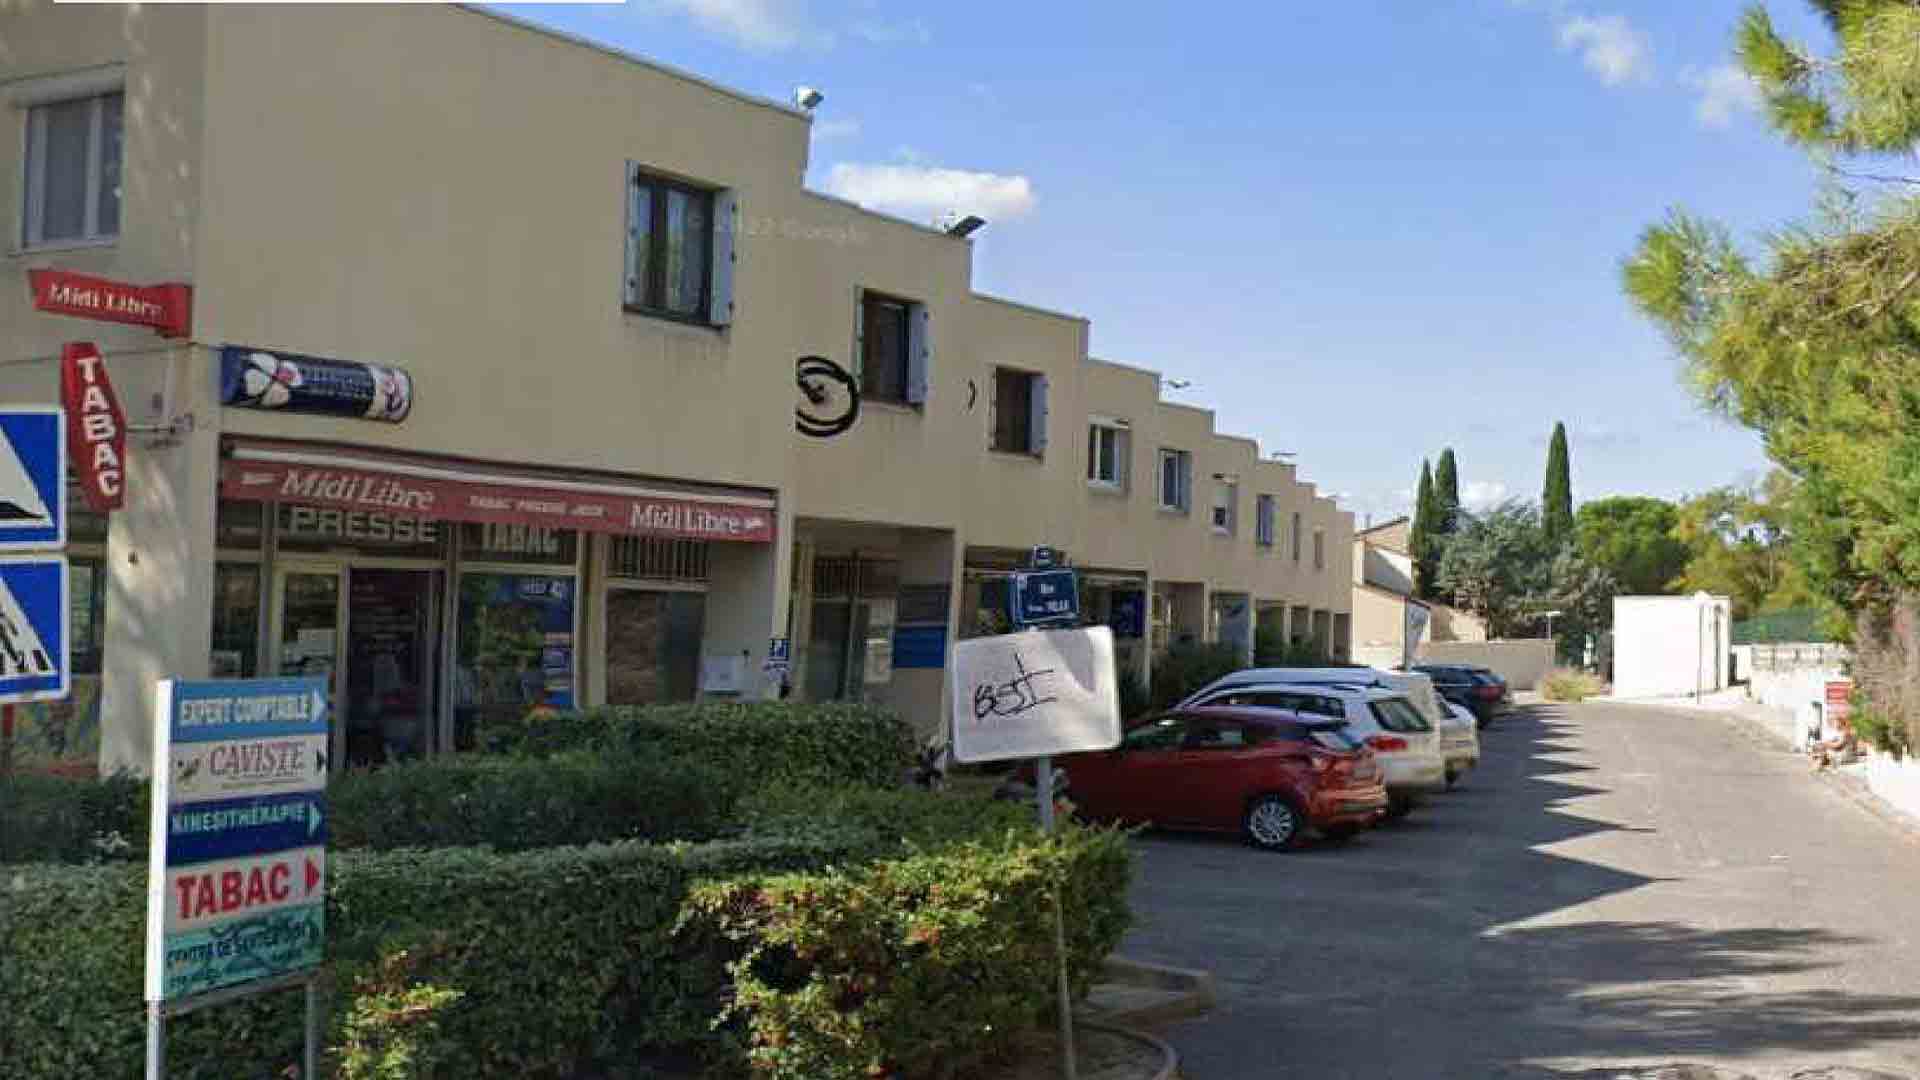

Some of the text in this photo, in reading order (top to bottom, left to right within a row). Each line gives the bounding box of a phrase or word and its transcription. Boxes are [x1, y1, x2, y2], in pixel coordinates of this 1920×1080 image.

[50, 283, 99, 309] Midi
[77, 357, 121, 496] TABAC
[281, 469, 435, 511] Midi Libre
[289, 506, 438, 544] PRESSE
[630, 503, 742, 535] Midi Libre
[482, 524, 559, 554] TABAC
[231, 691, 311, 722] COMPTABLE
[208, 740, 307, 777] CAVISTE
[176, 862, 292, 920] TABAC
